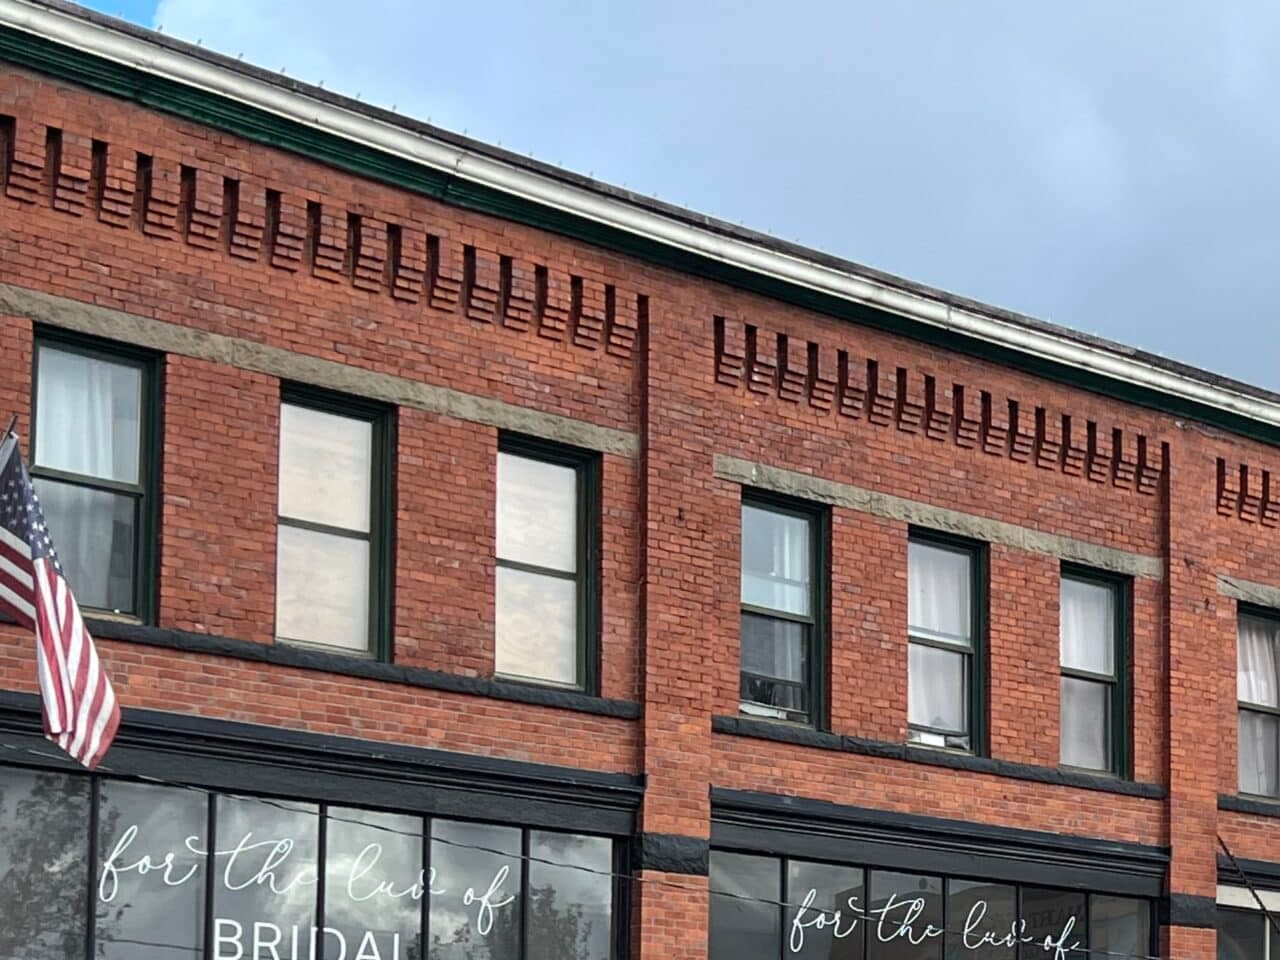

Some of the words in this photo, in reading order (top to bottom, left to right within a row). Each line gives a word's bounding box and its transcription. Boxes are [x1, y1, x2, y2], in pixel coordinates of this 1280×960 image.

[99, 825, 199, 902] for
[186, 832, 319, 895] the
[348, 843, 446, 902] luv
[463, 866, 515, 935] of
[790, 889, 858, 952] for
[848, 894, 945, 945] the
[963, 900, 1033, 949] luv
